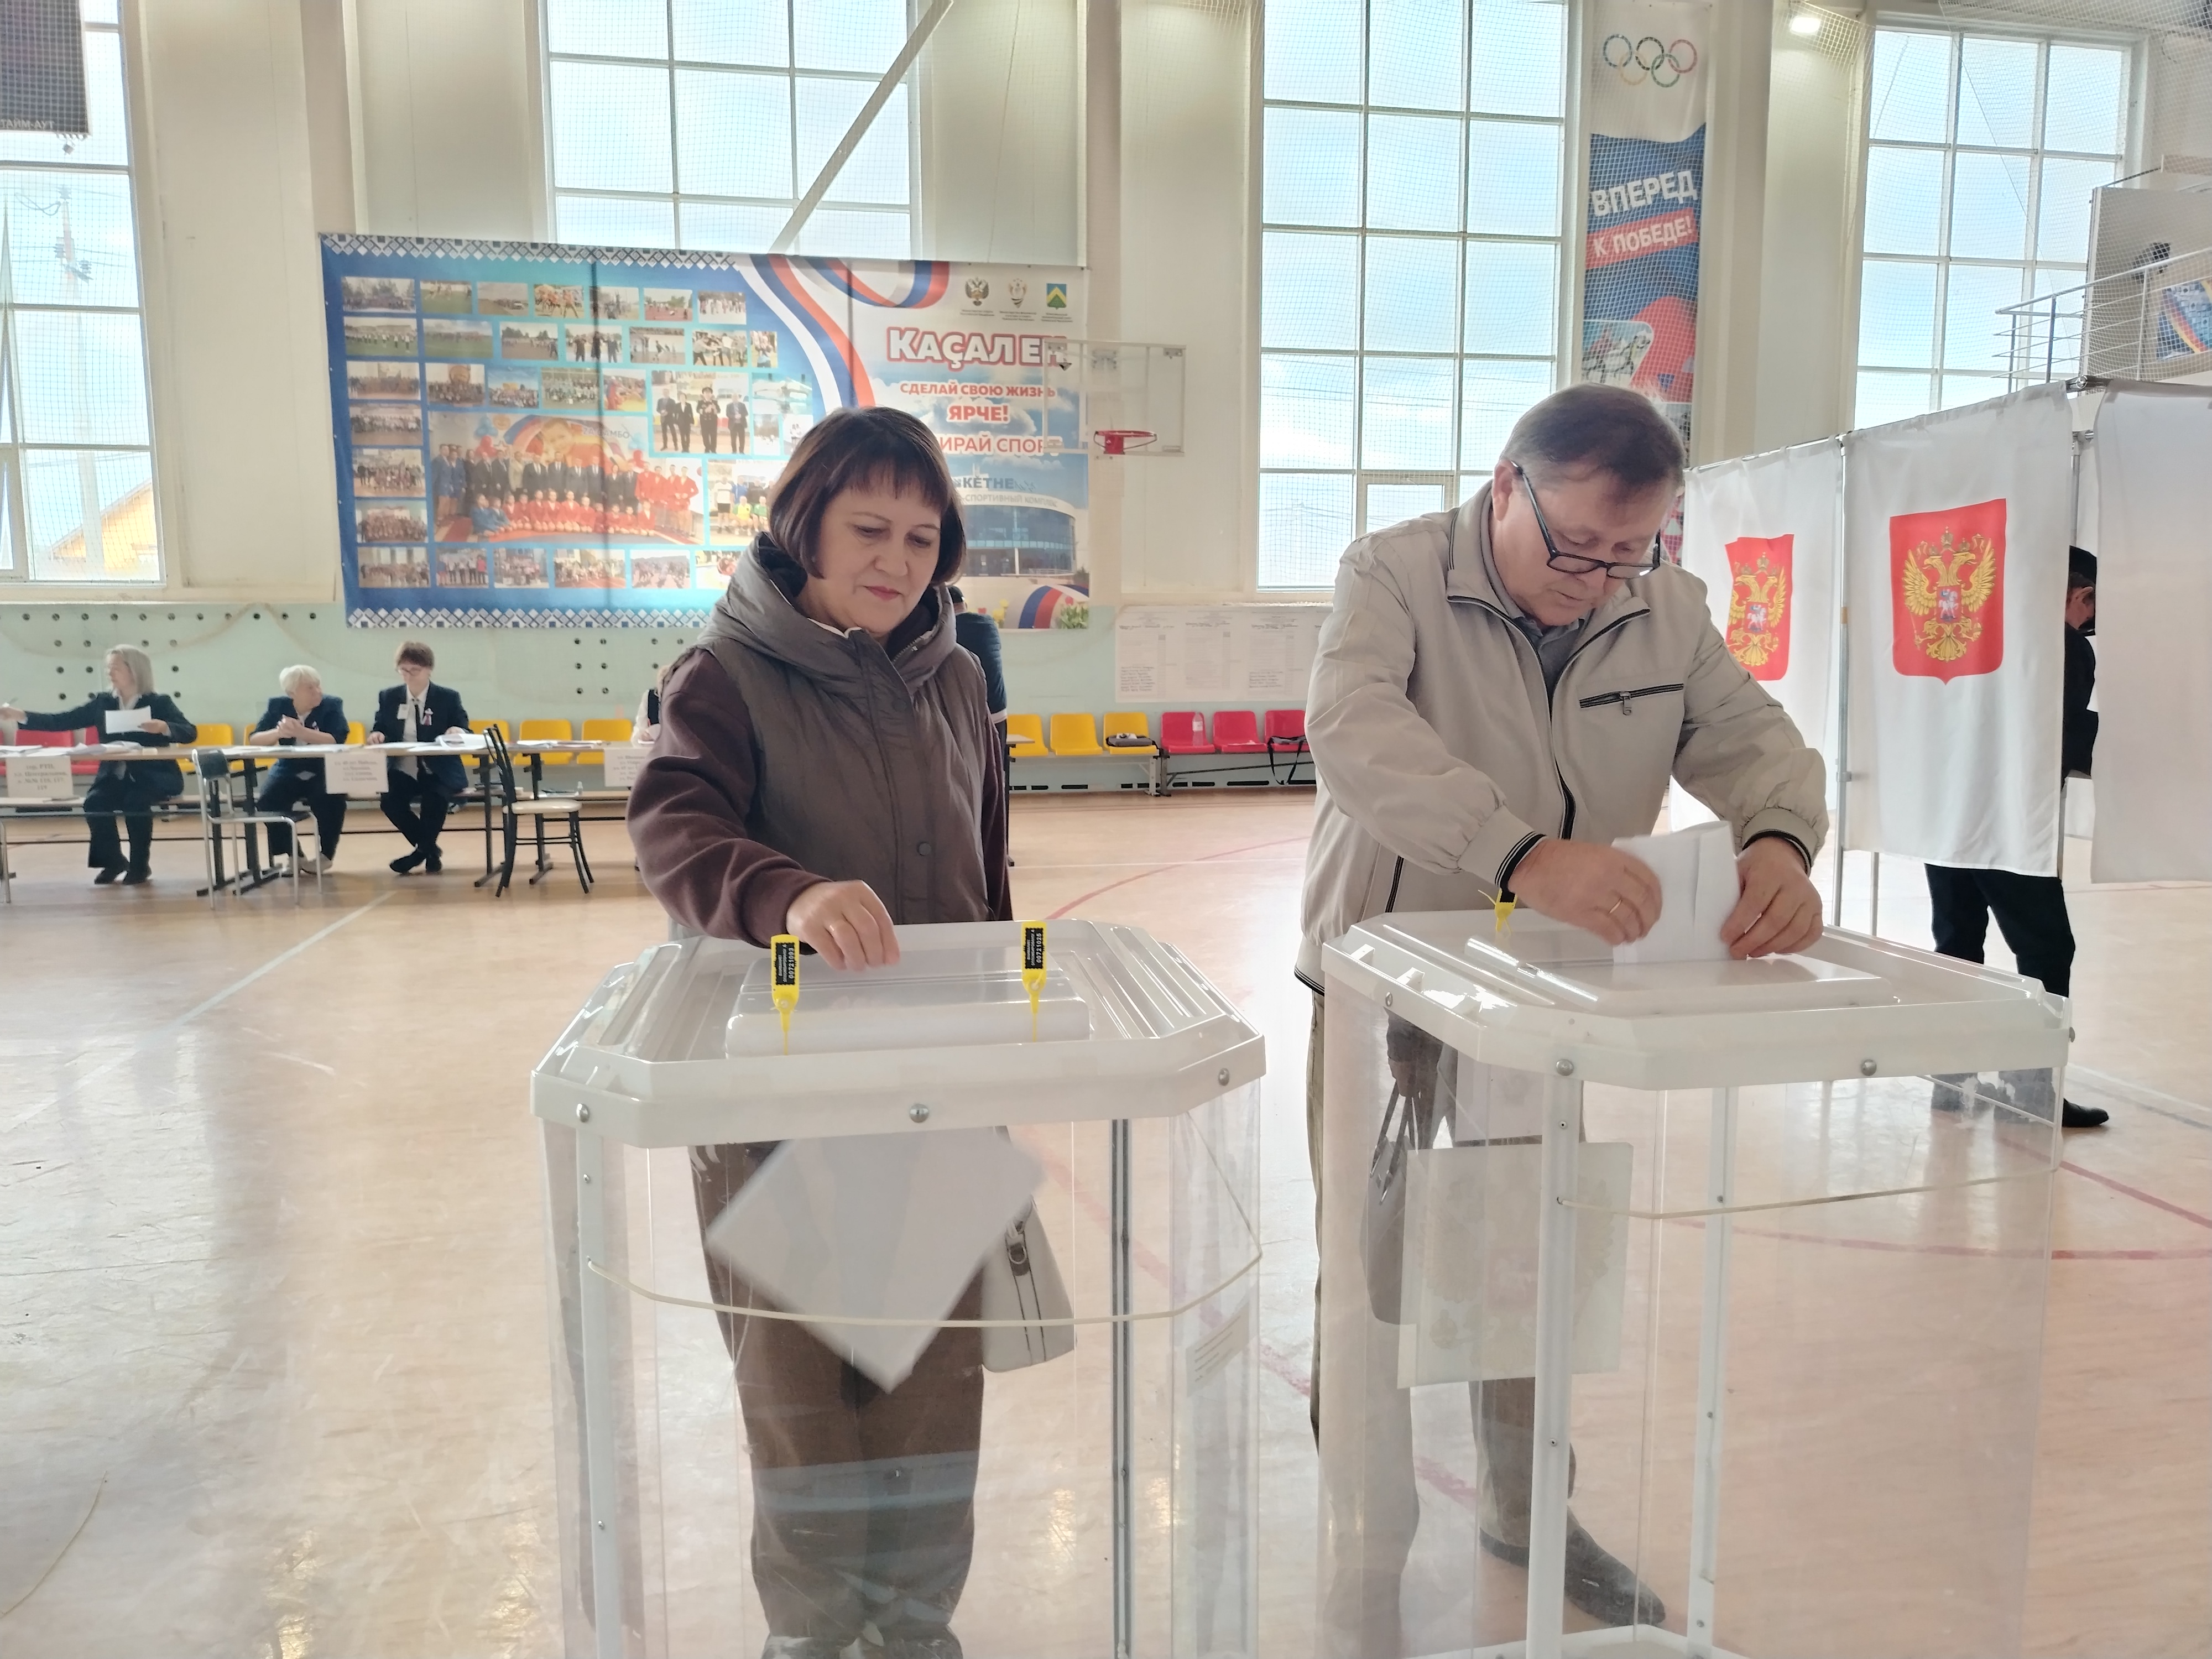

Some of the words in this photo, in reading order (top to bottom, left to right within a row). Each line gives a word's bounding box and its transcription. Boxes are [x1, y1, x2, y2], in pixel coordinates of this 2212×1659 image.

[0, 118, 55, 129] ТАЙМ-АУТ
[1592, 170, 1698, 216] ВПЕРЕД
[1594, 236, 1606, 257] К
[1613, 216, 1693, 254] ПОБЕДЕ!
[900, 381, 958, 395] СДЕЛАЙ
[960, 384, 1003, 396] СВОЮ
[948, 405, 1009, 422] ЯРЧЕ!
[940, 434, 992, 452] ИРАЙ
